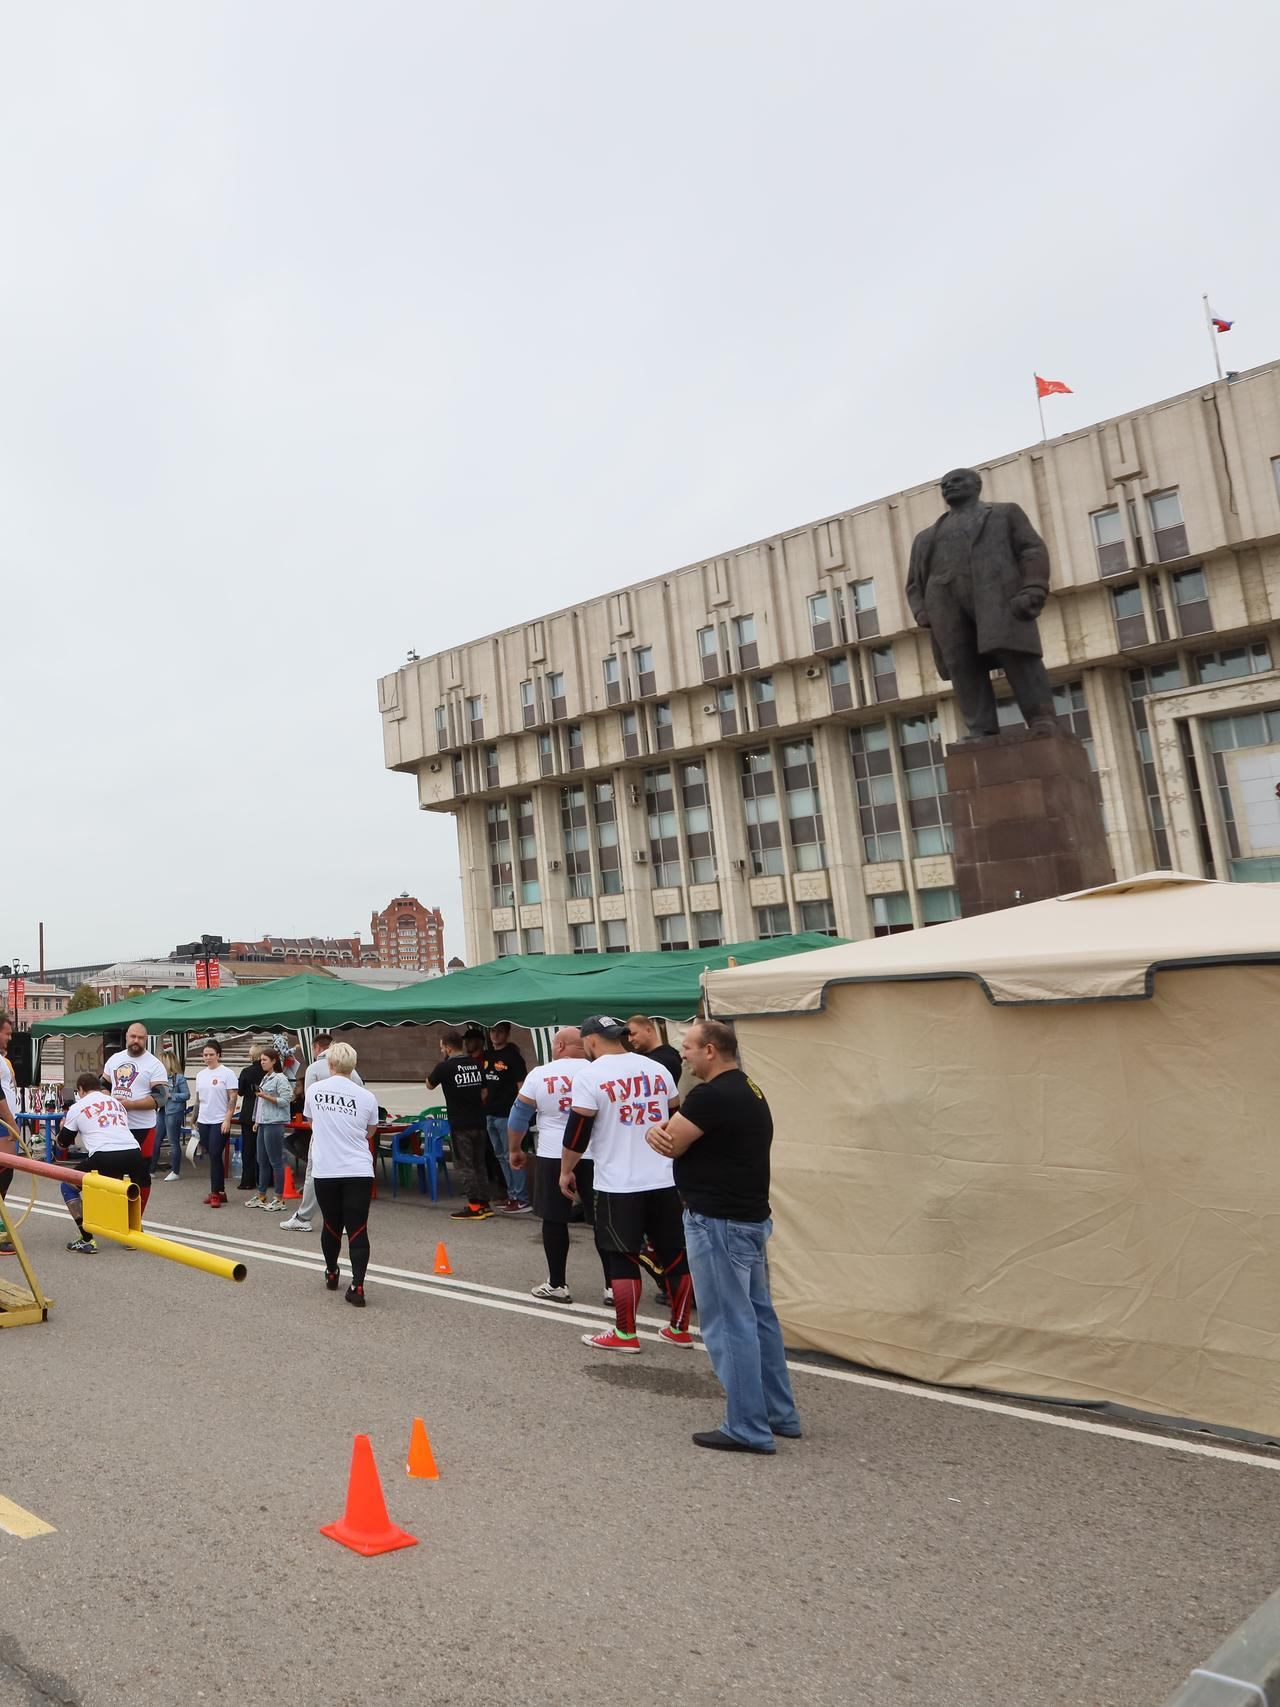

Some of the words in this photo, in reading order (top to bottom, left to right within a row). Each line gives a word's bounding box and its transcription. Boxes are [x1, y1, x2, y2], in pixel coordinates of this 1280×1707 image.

[454, 1071, 482, 1085] СИЛА
[543, 1076, 573, 1095] ТУ
[600, 1070, 668, 1103] ТУЛА
[314, 1093, 357, 1110] СИЛА
[338, 1106, 357, 1117] 2021
[620, 1101, 662, 1126] 875
[98, 1113, 127, 1128] 875
